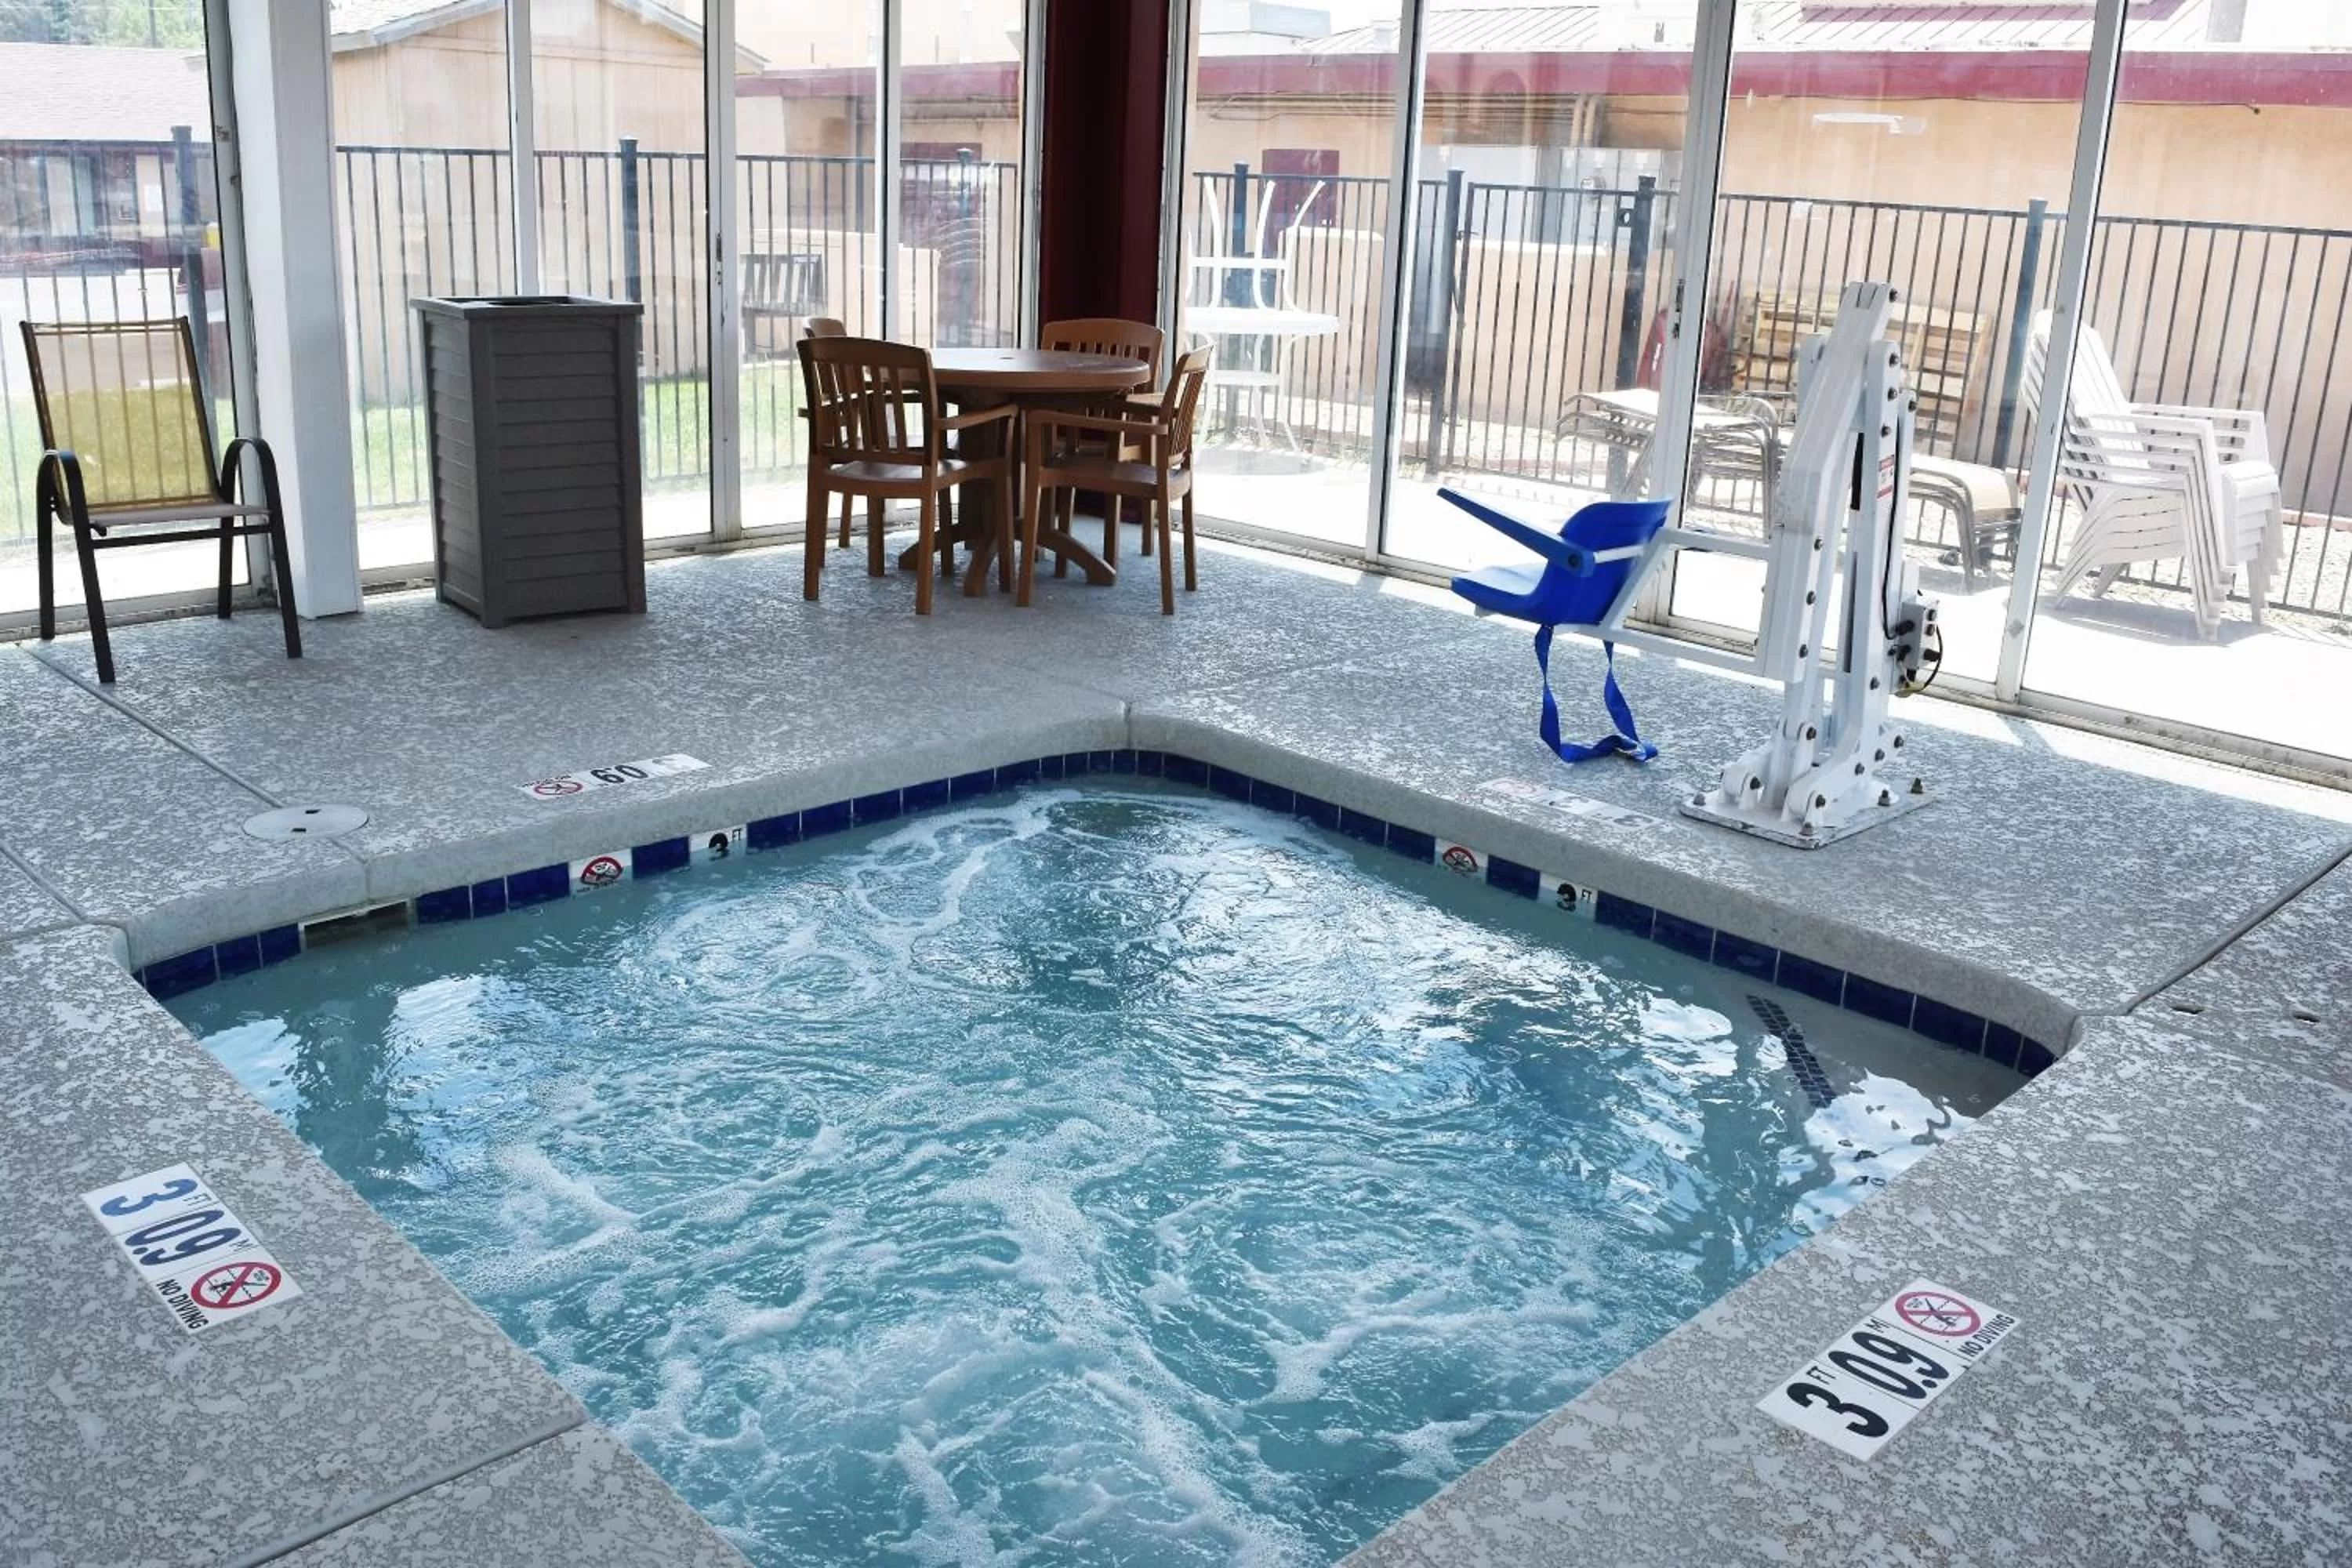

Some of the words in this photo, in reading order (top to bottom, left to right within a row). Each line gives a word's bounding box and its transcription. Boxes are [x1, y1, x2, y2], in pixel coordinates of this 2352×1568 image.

[732, 828, 742, 841] FT
[1581, 889, 1592, 903] FT
[100, 1178, 198, 1217] 3
[183, 1193, 212, 1206] FT
[125, 1210, 241, 1266] 0.9
[229, 1239, 256, 1252] M
[156, 1279, 182, 1296] NO
[167, 1293, 209, 1329] DIVING
[1863, 1318, 1890, 1334] M
[1957, 1341, 1984, 1357] NO
[1972, 1313, 2015, 1345] DIVING
[1806, 1365, 1836, 1385] FT
[1828, 1331, 1949, 1399] 0.9
[1786, 1382, 1889, 1438] 3
